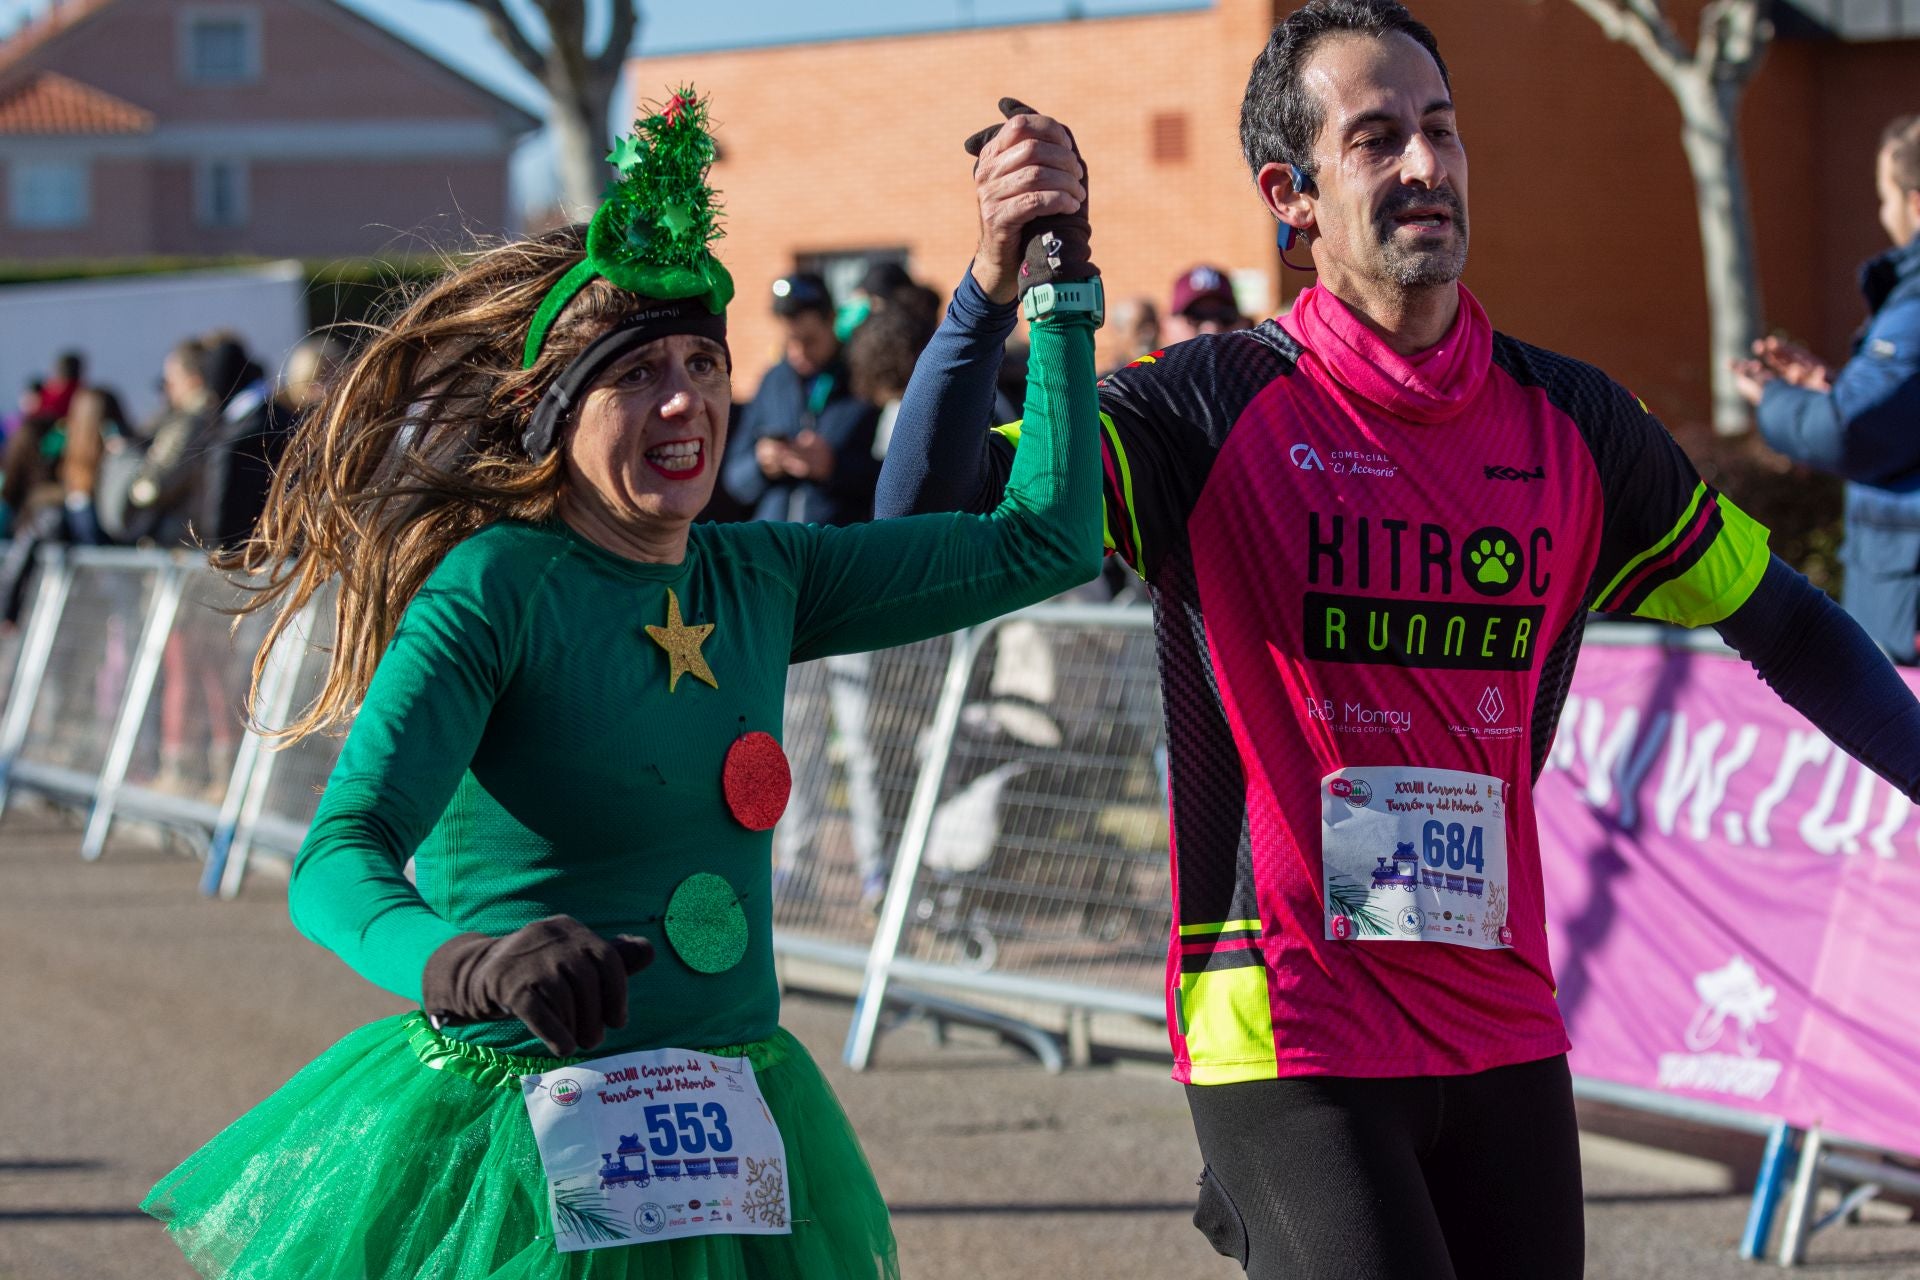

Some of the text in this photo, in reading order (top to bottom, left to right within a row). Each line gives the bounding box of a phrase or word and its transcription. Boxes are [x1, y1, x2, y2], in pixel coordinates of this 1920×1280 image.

[1307, 511, 1553, 598] KITROC
[1325, 606, 1532, 659] RUNNER
[1344, 702, 1412, 732] Monroy
[1464, 782, 1478, 796] del
[1425, 802, 1435, 815] y
[1436, 798, 1451, 811] del
[1422, 819, 1485, 874] 684
[641, 1064, 685, 1078] Carrera
[686, 1059, 702, 1072] del
[643, 1087, 655, 1101] y
[656, 1078, 675, 1092] del
[643, 1101, 733, 1157] 553
